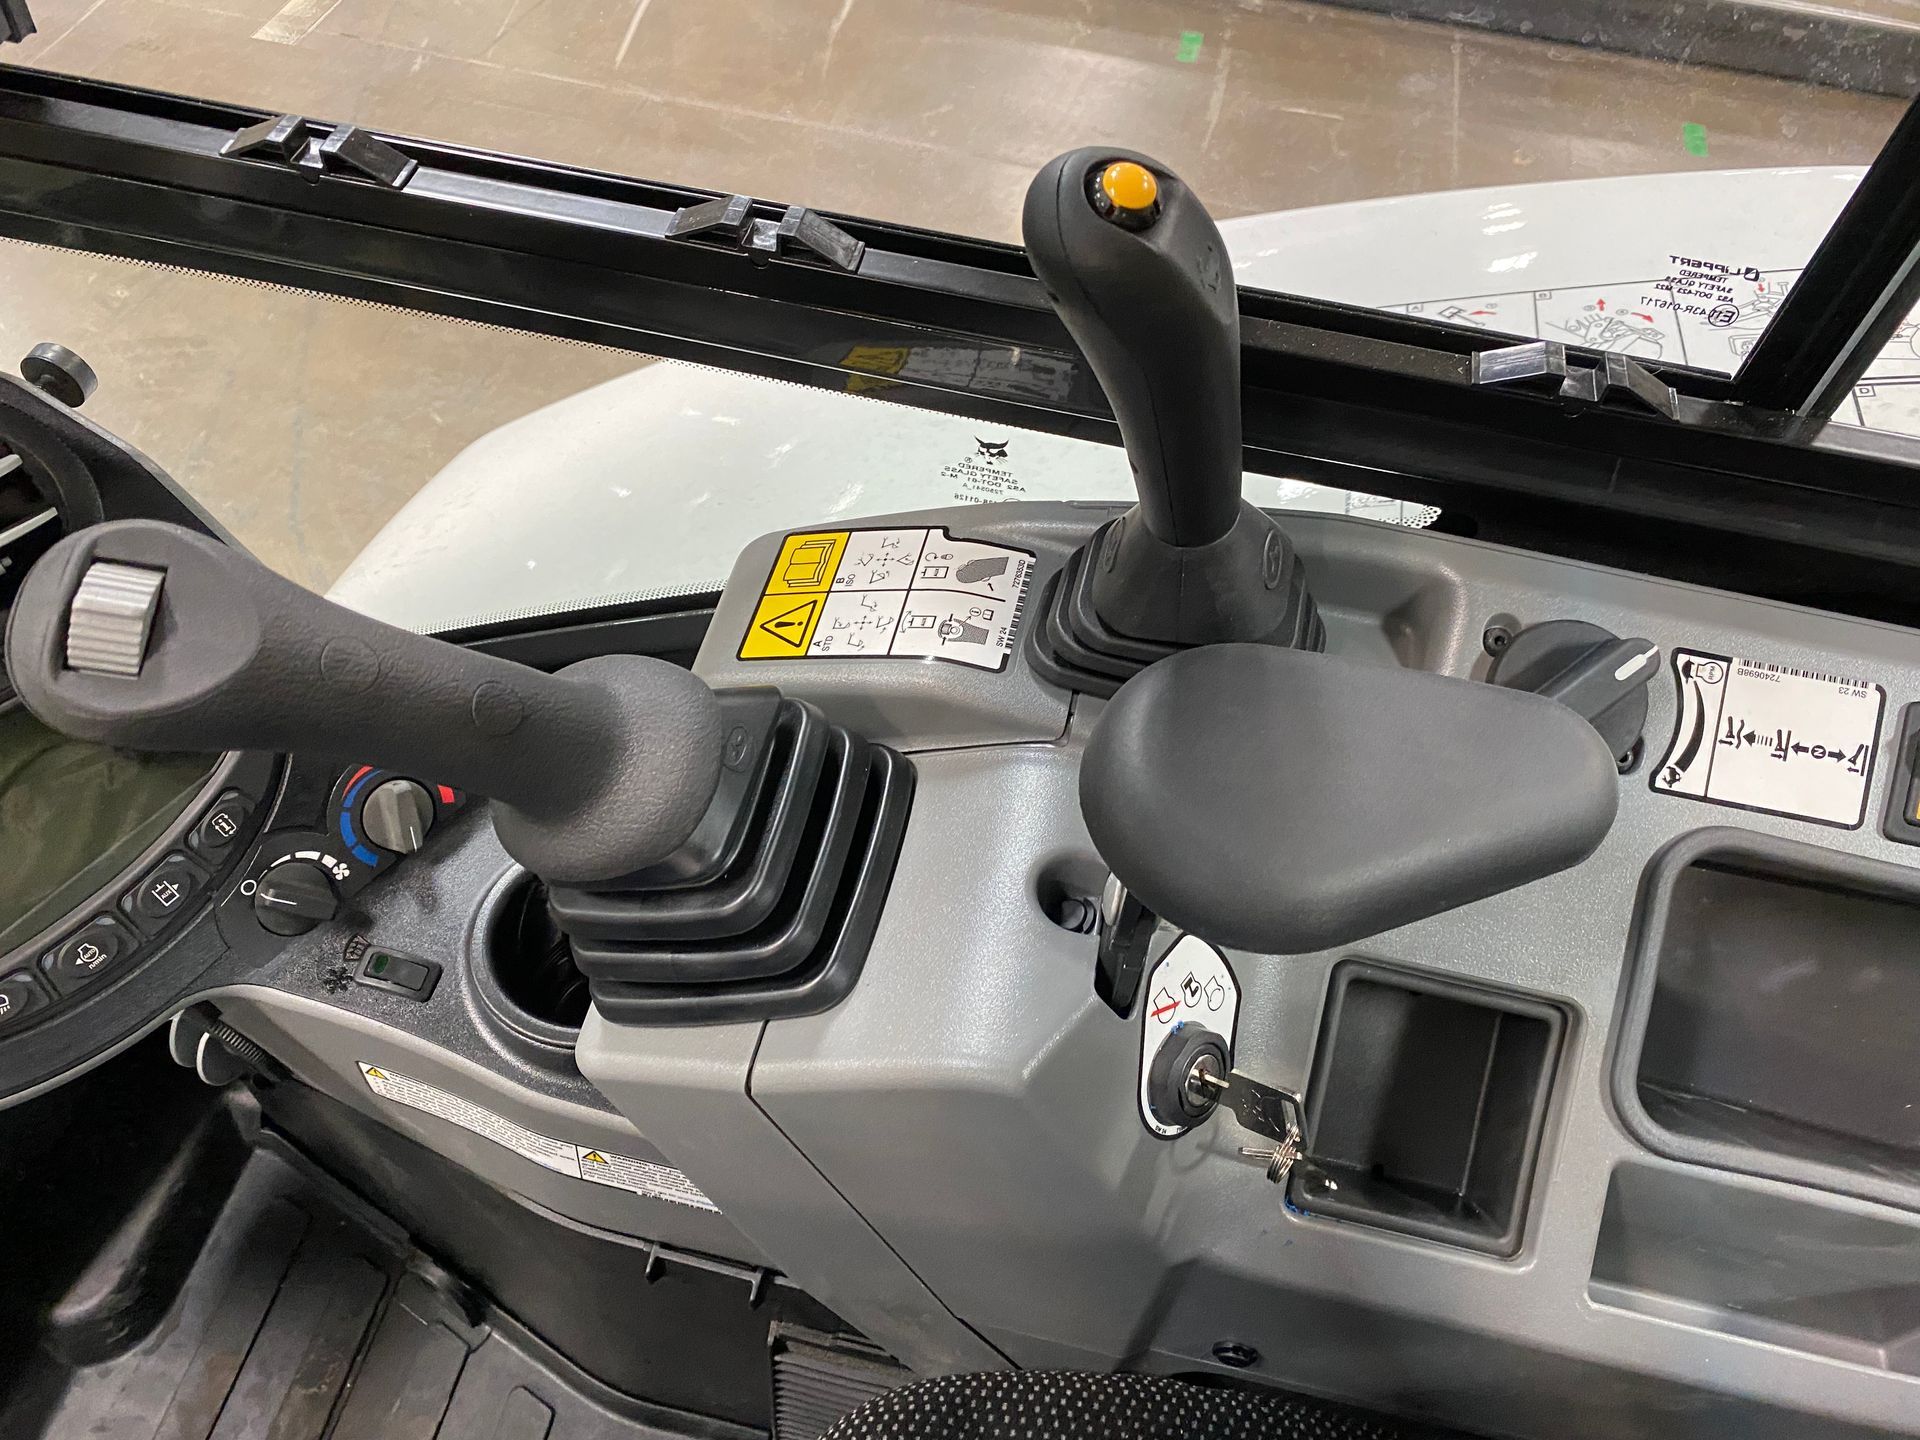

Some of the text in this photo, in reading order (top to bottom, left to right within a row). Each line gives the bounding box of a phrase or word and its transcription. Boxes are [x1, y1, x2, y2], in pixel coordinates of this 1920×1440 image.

[845, 573, 856, 587] ISO
[821, 635, 834, 652] STD
[996, 626, 1007, 648] SW 24
[1737, 667, 1780, 683] 7240698B
[1838, 686, 1868, 699] SW 23
[83, 948, 96, 959] AUTO
